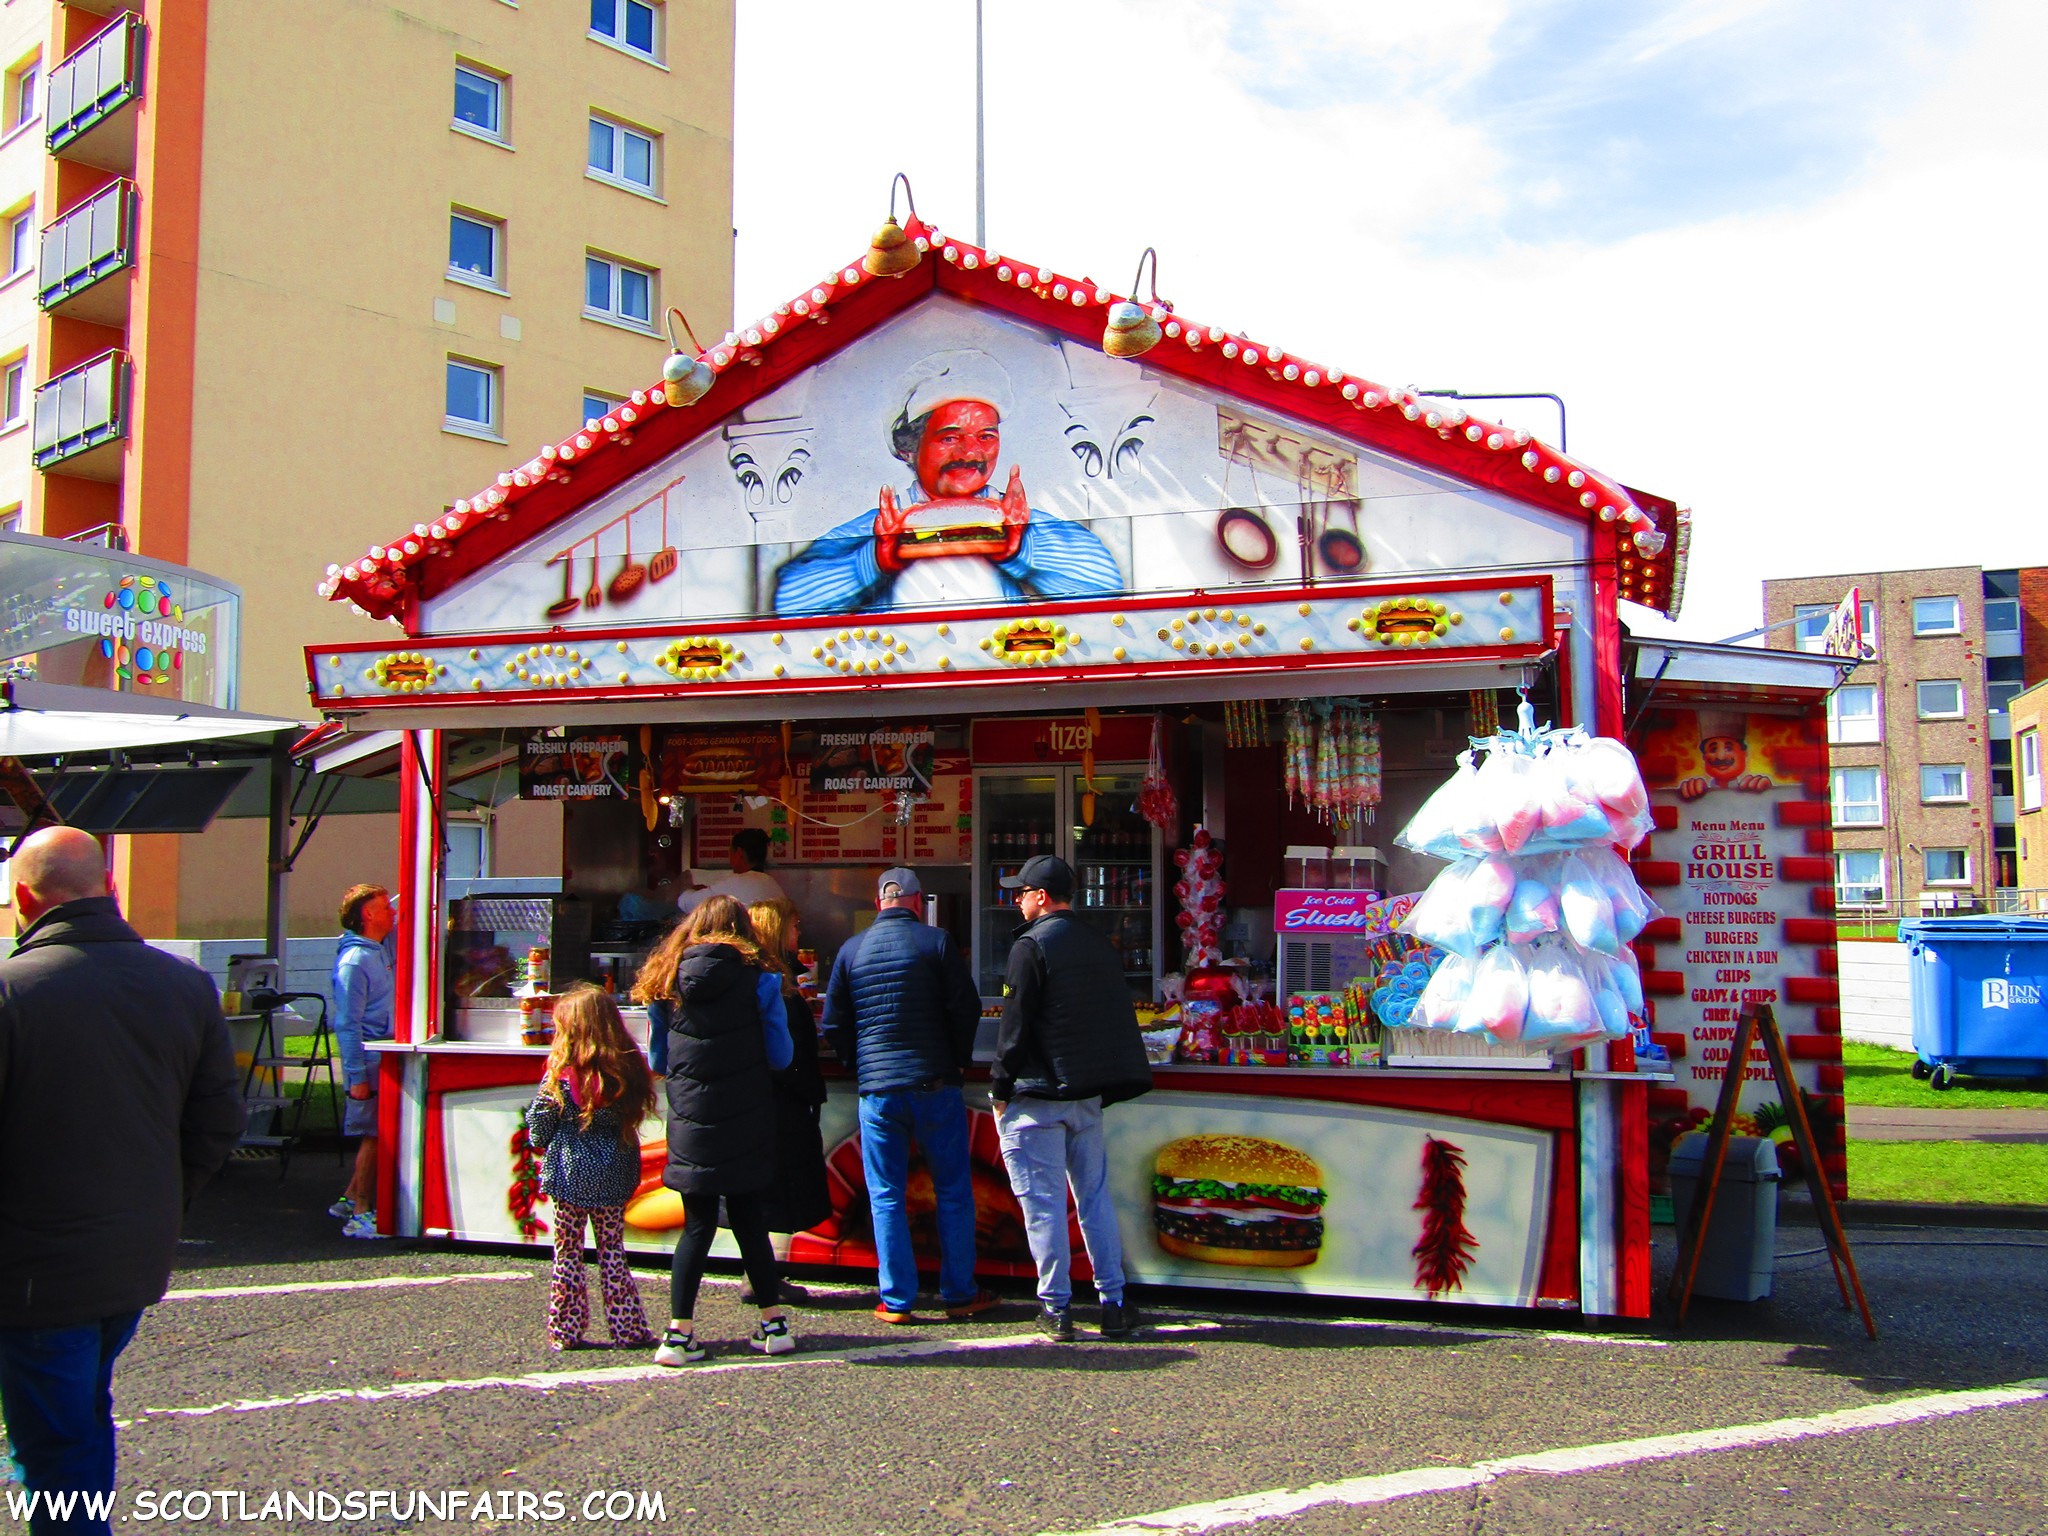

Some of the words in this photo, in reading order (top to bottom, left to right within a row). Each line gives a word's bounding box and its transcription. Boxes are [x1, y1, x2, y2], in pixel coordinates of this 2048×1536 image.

[66, 608, 136, 640] sweet
[141, 620, 206, 654] express
[667, 738, 709, 746] FOOT-LONG
[709, 736, 740, 745] GERMAN
[740, 736, 755, 744] HOT
[756, 735, 777, 744] DOGS
[821, 733, 867, 746] FRESHLY
[869, 731, 928, 745] PREPARED
[527, 742, 568, 754] FRESHLY
[569, 741, 620, 753] PREPARED
[824, 777, 862, 790] ROAST
[863, 776, 915, 790] CARVERY
[533, 784, 565, 797] ROAST
[567, 784, 612, 796] CARVERY
[1691, 821, 1726, 831] Menu
[1730, 820, 1765, 831] Menu
[1692, 844, 1767, 860] GRILL
[1687, 862, 1773, 878] HOUSE
[1302, 895, 1323, 906] Ice
[1324, 896, 1355, 906] Cold
[1703, 892, 1757, 905] HOTDOGS
[1285, 908, 1366, 928] Slush
[1686, 911, 1725, 924] CHEESE
[1728, 911, 1776, 924] BURGERS
[1705, 931, 1759, 944] BURGERS
[1686, 951, 1731, 964] CHICKEN
[1733, 951, 1745, 964] IN
[1746, 951, 1755, 964] A
[1756, 951, 1778, 964] BUN
[1716, 969, 1751, 983] CHIPS
[1691, 988, 1728, 1003] GRAVY
[1729, 988, 1739, 1003] &
[1741, 989, 1777, 1003] CHIPS
[1986, 981, 2042, 1004] BINN
[1703, 1007, 1731, 1021] CURRY
[1693, 1027, 1735, 1041] CANDY
[1703, 1047, 1729, 1061] COLD
